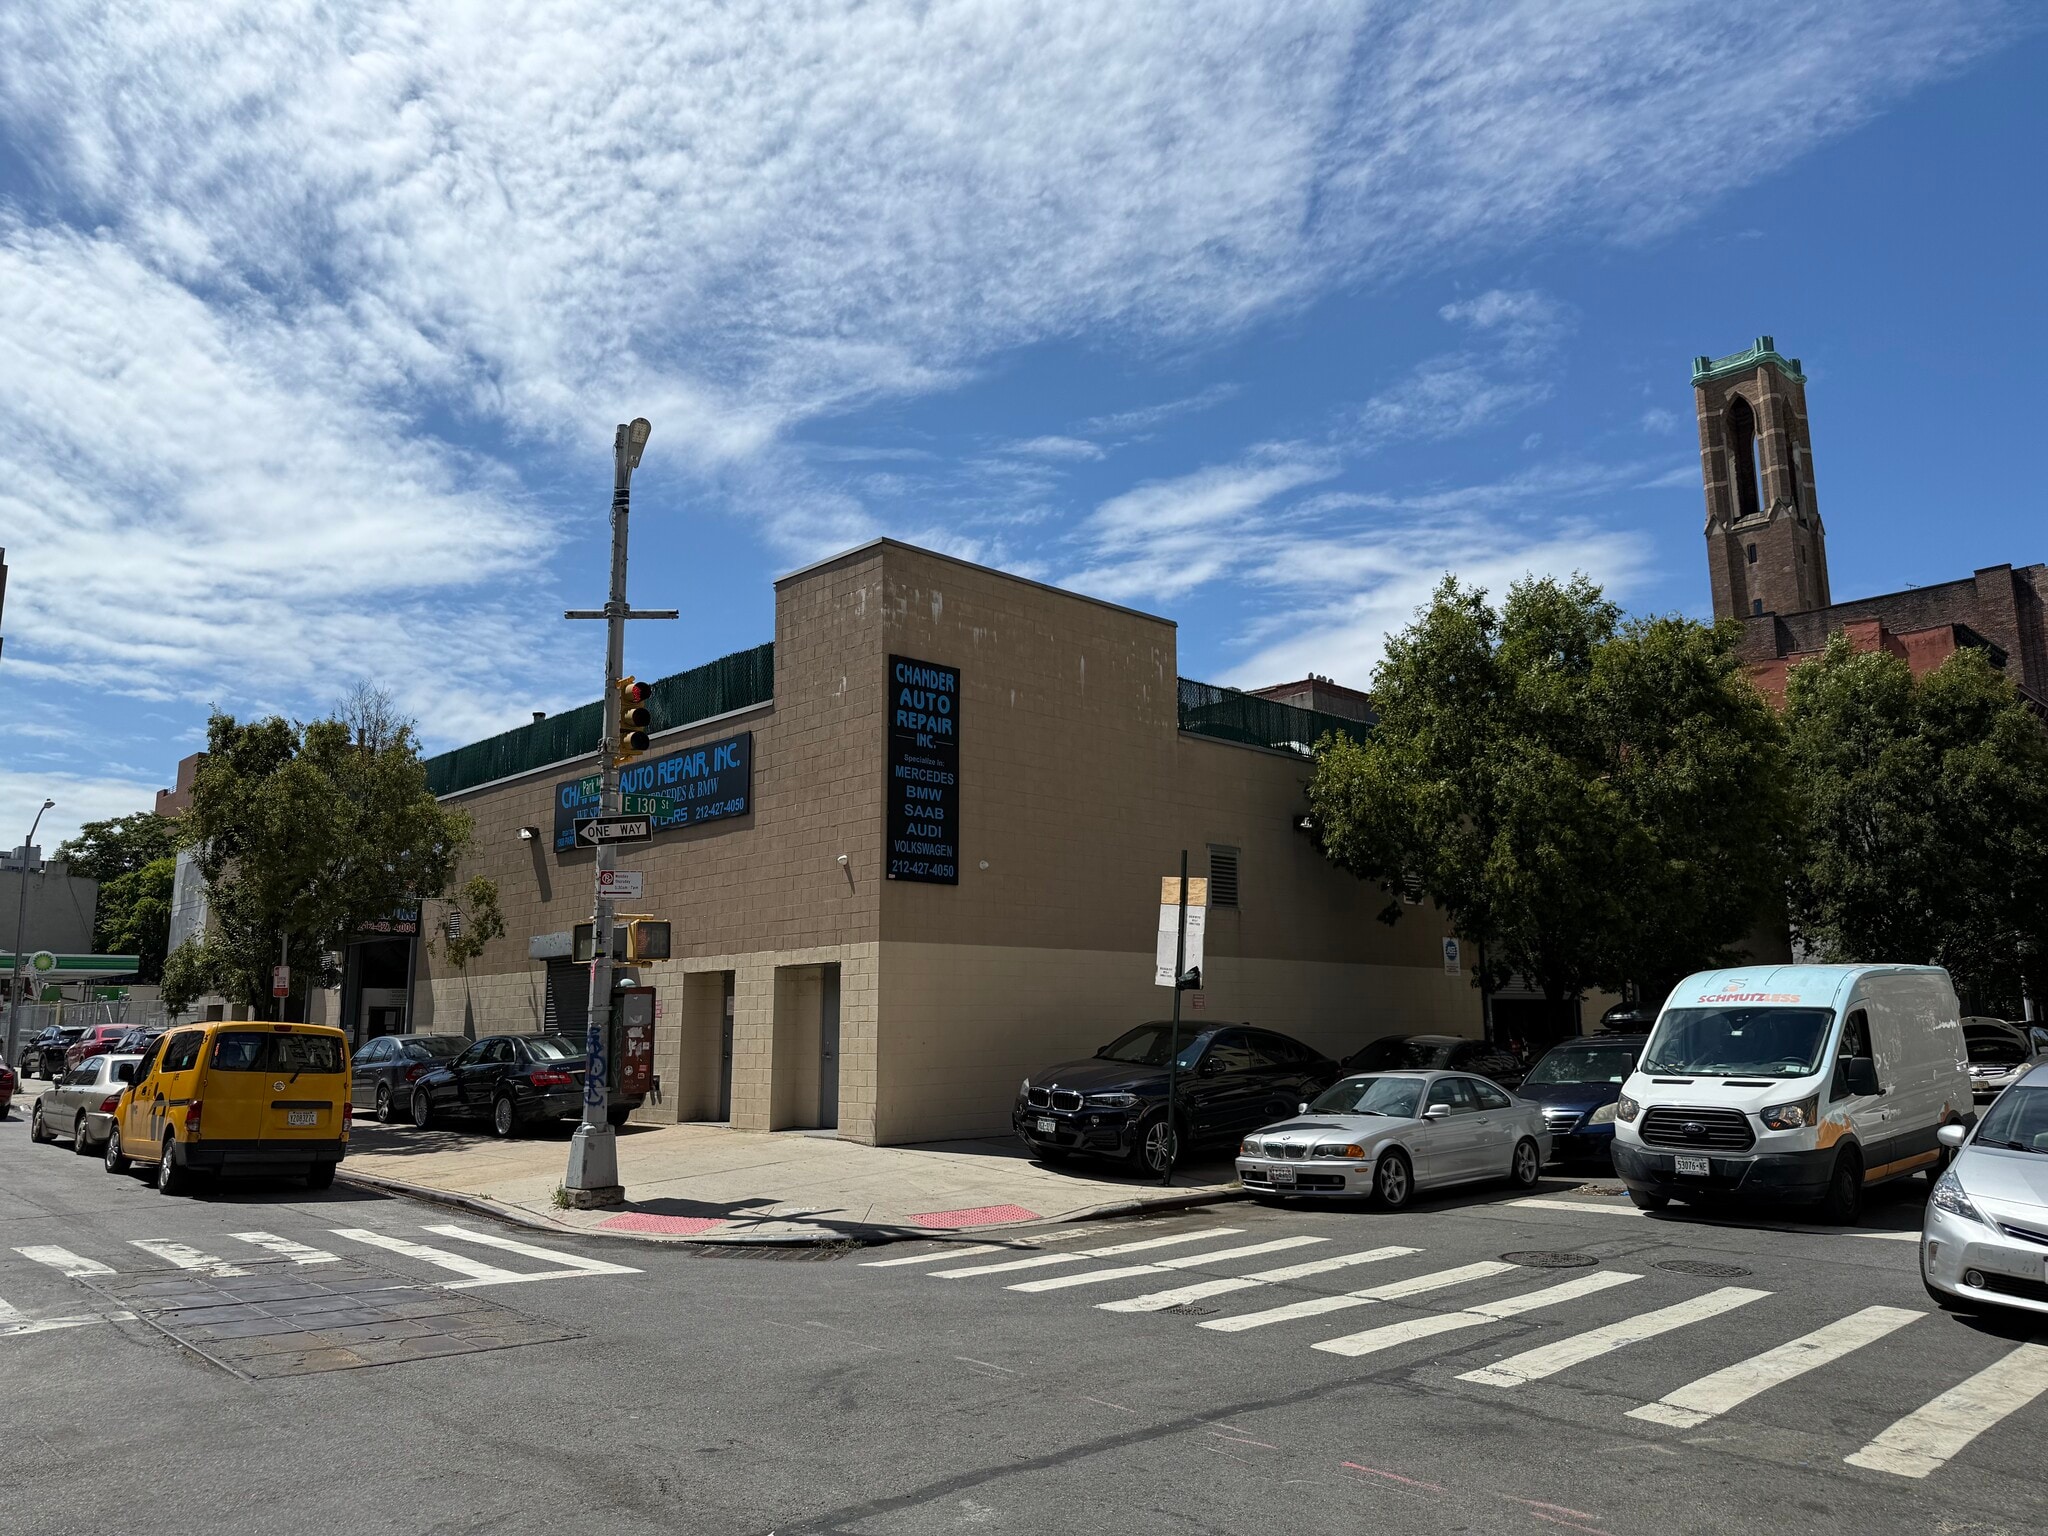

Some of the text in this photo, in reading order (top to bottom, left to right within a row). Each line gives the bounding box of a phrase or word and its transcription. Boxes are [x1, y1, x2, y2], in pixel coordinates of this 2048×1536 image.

[896, 663, 954, 693] CHANDER
[900, 687, 950, 714] AUTO
[896, 709, 952, 736] REPAIR
[916, 733, 936, 749] INC.
[619, 742, 740, 794] AUTO REPAIR, INC.
[895, 764, 954, 786] MERCEDES
[582, 779, 595, 796] Park
[688, 783, 696, 800] &
[697, 777, 720, 798] BMW
[906, 784, 943, 802] BMW
[624, 796, 669, 814] E 130 St
[695, 797, 744, 820] 212-427-4050
[904, 803, 945, 820] SAAB
[587, 825, 610, 838] ONE
[620, 823, 642, 835] WAY
[905, 822, 942, 839] AUDI
[894, 839, 953, 858] VOLKSWAGEN
[891, 859, 954, 878] 212-427-4050
[1697, 993, 1801, 1003] SCHMUTZLESS
